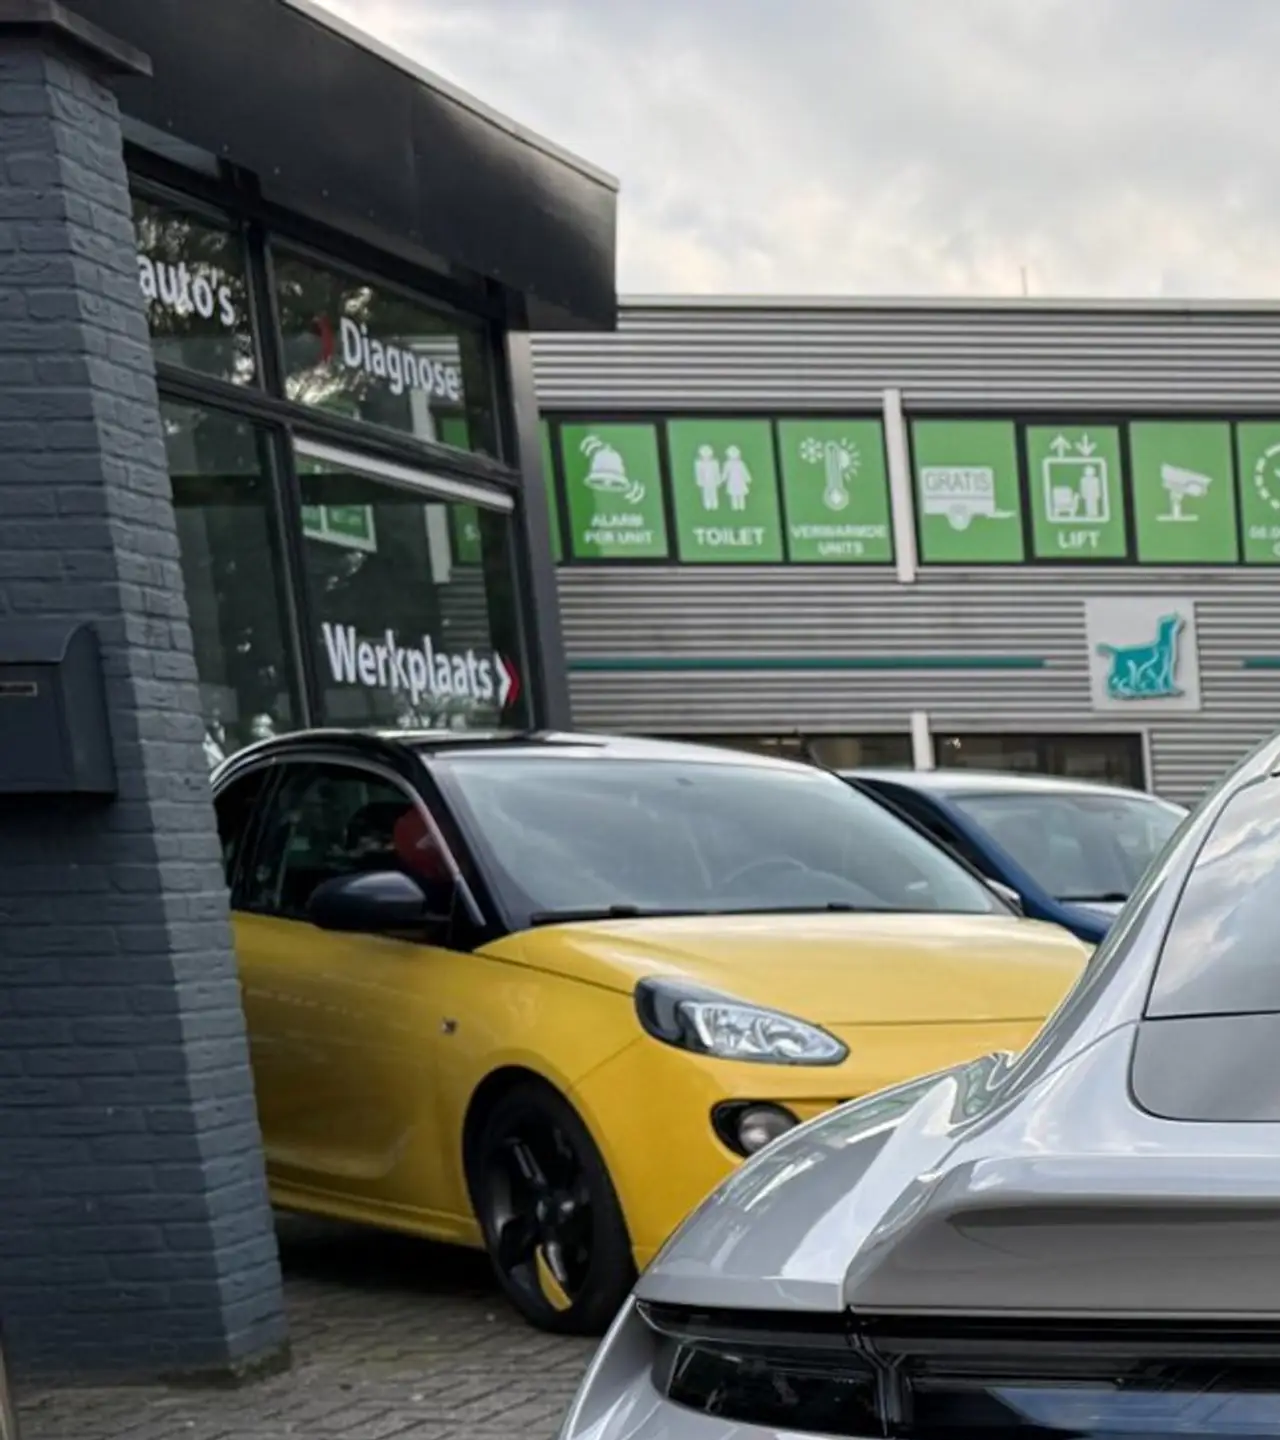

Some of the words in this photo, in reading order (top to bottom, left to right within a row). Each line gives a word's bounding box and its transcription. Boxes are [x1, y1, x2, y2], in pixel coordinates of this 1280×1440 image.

[137, 255, 236, 327] auto's
[340, 316, 460, 401] Diagnose
[925, 471, 990, 492] GRATIS
[591, 512, 644, 527] ALARM
[692, 526, 766, 546] TOILET
[1057, 531, 1101, 549] LIFT
[817, 540, 865, 556] UNITS
[321, 622, 494, 706] Werkplaats
